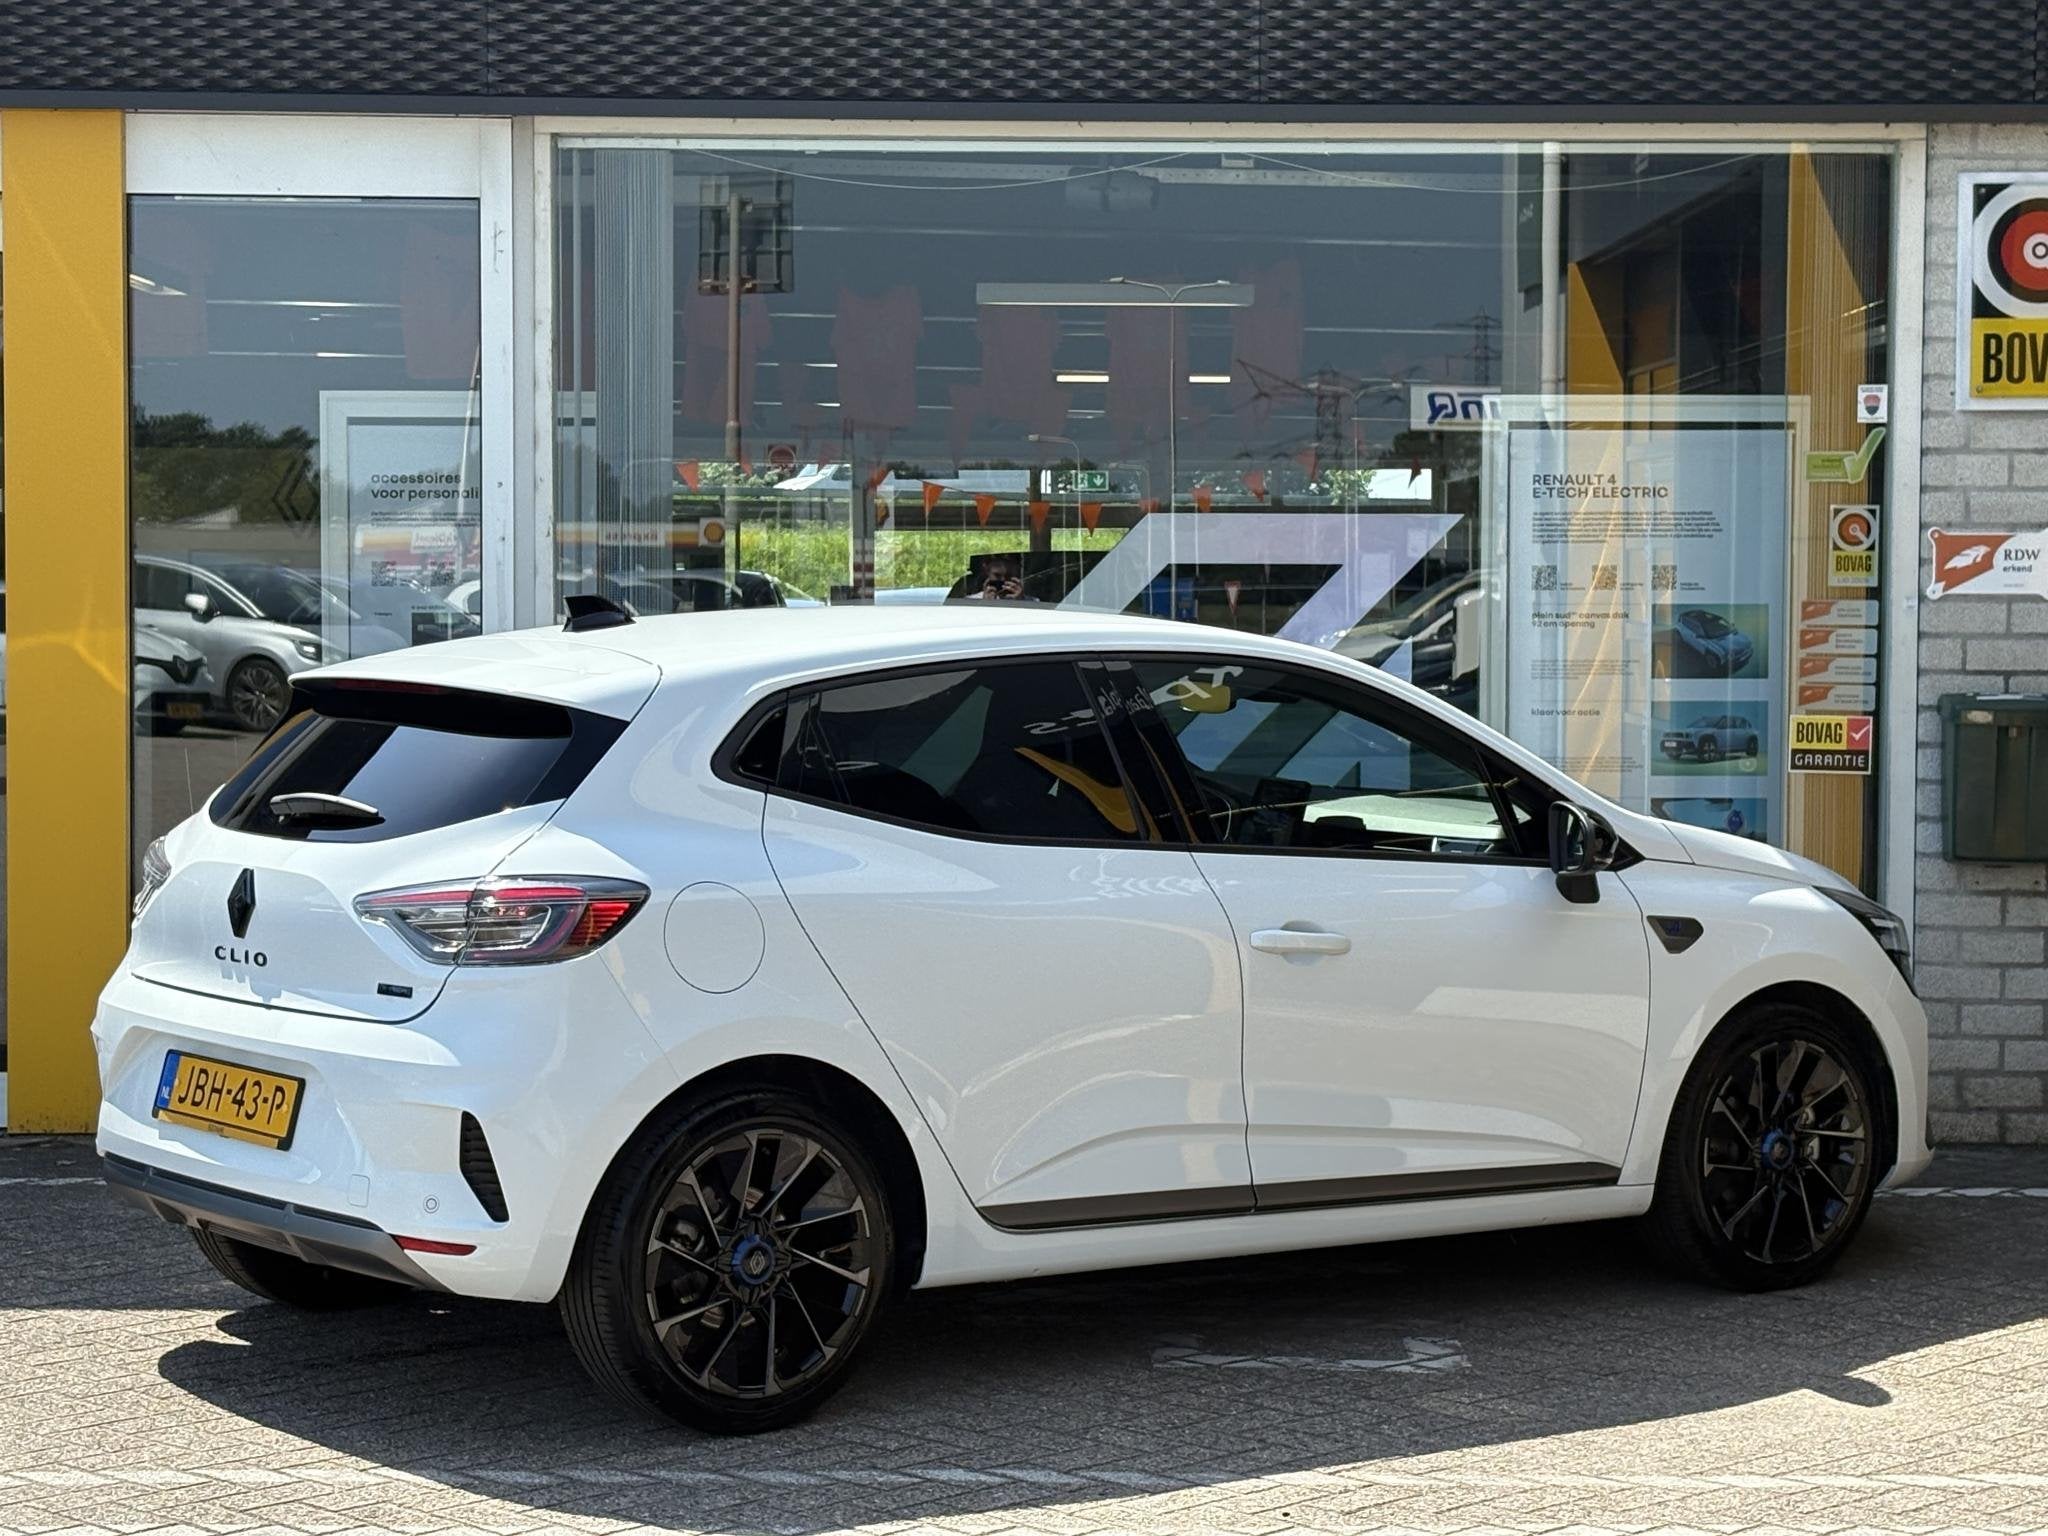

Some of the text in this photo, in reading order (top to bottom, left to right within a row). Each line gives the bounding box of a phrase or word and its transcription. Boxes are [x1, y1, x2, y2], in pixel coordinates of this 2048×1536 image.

[371, 472, 462, 484] accessoires
[1532, 474, 1617, 486] RENAULT 4
[371, 489, 405, 499] voor
[1532, 487, 1669, 498] E-TECH ELECTRIC
[2003, 548, 2040, 561] RDW
[1835, 555, 1872, 572] BOVAG
[2002, 564, 2033, 573] erkend
[1559, 621, 1595, 629] opening
[1531, 708, 1554, 716] klaar
[1577, 708, 1601, 716] actie
[1796, 721, 1843, 744] BOVAG
[1794, 753, 1866, 767] GARANTIE
[214, 945, 268, 967] CLIO
[177, 1065, 286, 1125] JBH-43-P
